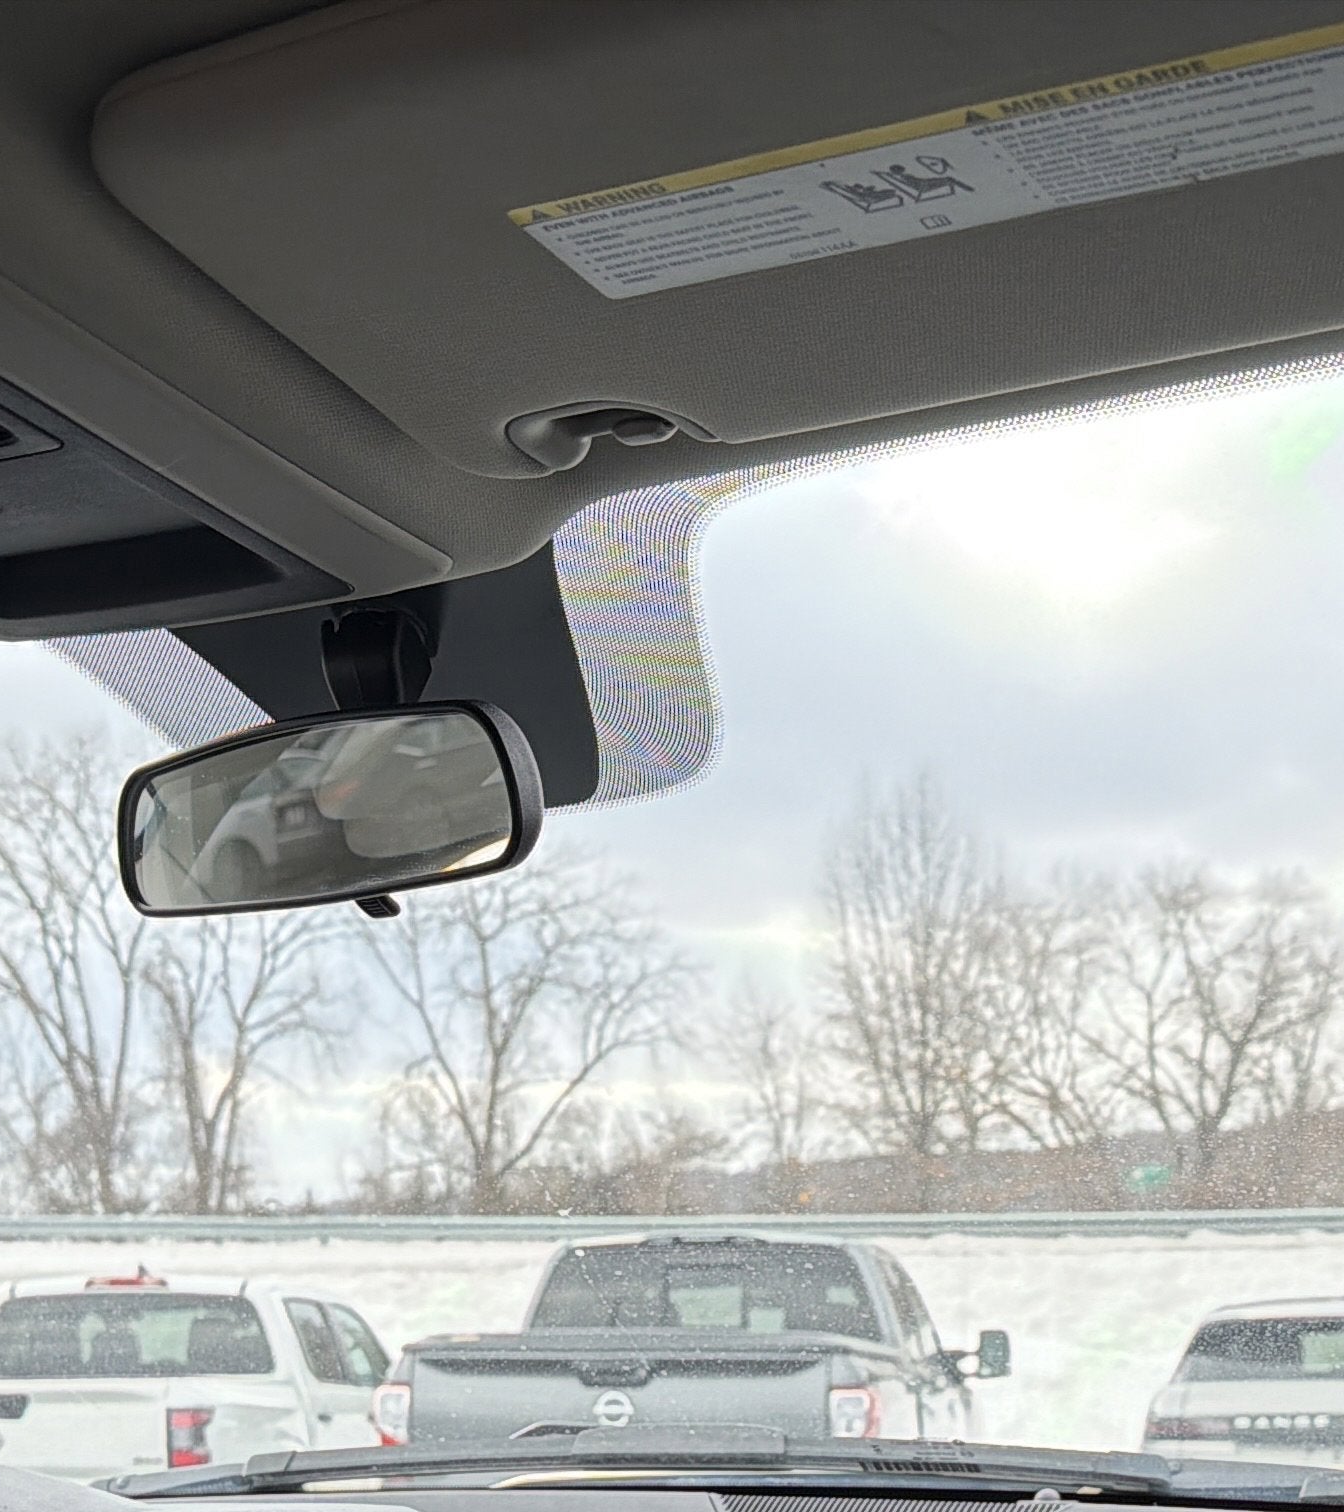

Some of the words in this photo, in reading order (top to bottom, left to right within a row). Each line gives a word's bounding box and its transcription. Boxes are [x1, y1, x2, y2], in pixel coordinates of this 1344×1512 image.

[999, 92, 1064, 113] MISE
[1070, 81, 1110, 98] EN
[1113, 60, 1203, 89] GARDE
[556, 183, 667, 215] WARNING
[576, 212, 609, 225] WITH
[610, 198, 677, 218] ADVANCED
[679, 186, 735, 203] AIRBAGS
